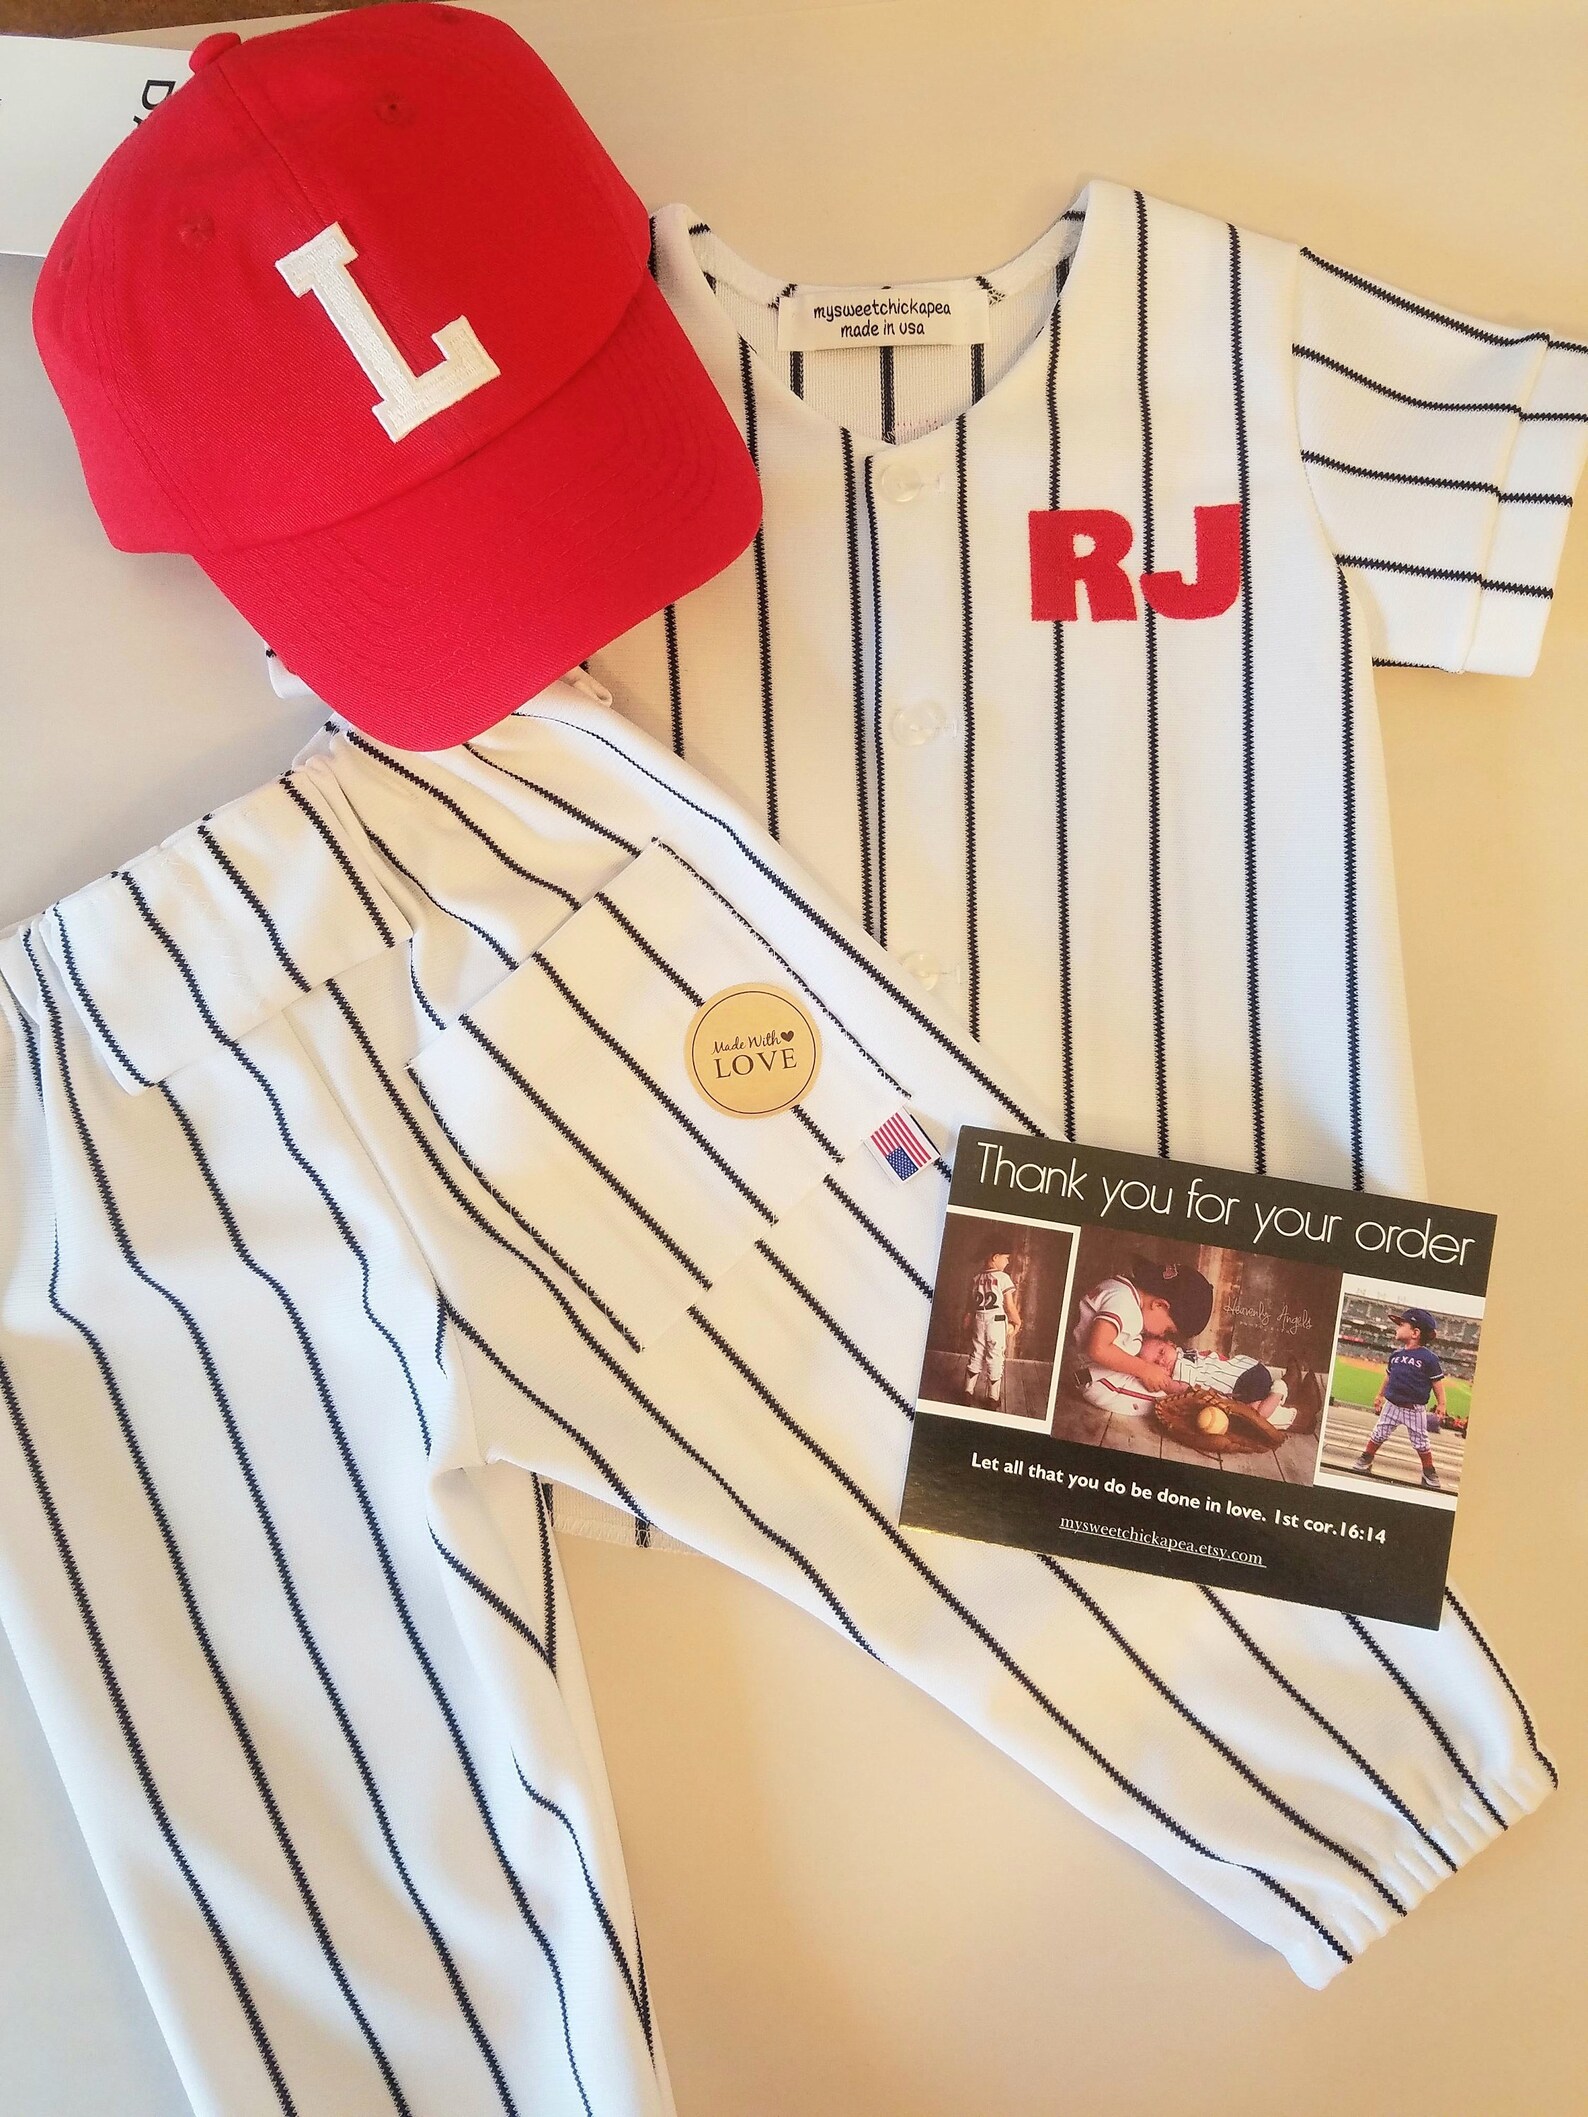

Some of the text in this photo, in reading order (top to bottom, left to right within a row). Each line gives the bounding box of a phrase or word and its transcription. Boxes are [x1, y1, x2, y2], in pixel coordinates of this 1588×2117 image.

[275, 221, 501, 444] L
[813, 298, 951, 322] mysweetchickapea
[840, 319, 925, 338] made in usa
[1027, 503, 1242, 622] RJ
[711, 1030, 781, 1054] Made With
[714, 1048, 797, 1079] LOVE
[977, 1142, 1476, 1266] Thank you for your order
[971, 1452, 999, 1472] Let
[1003, 1459, 1024, 1476] all
[1028, 1463, 1064, 1483] that
[1067, 1473, 1099, 1490] you
[1104, 1478, 1126, 1495] do
[1131, 1482, 1152, 1500] be
[1157, 1488, 1200, 1509] done
[1205, 1496, 1221, 1514] in
[1226, 1500, 1266, 1522] love.
[1059, 1517, 1266, 1567] mysweetchickapea.etsy.com
